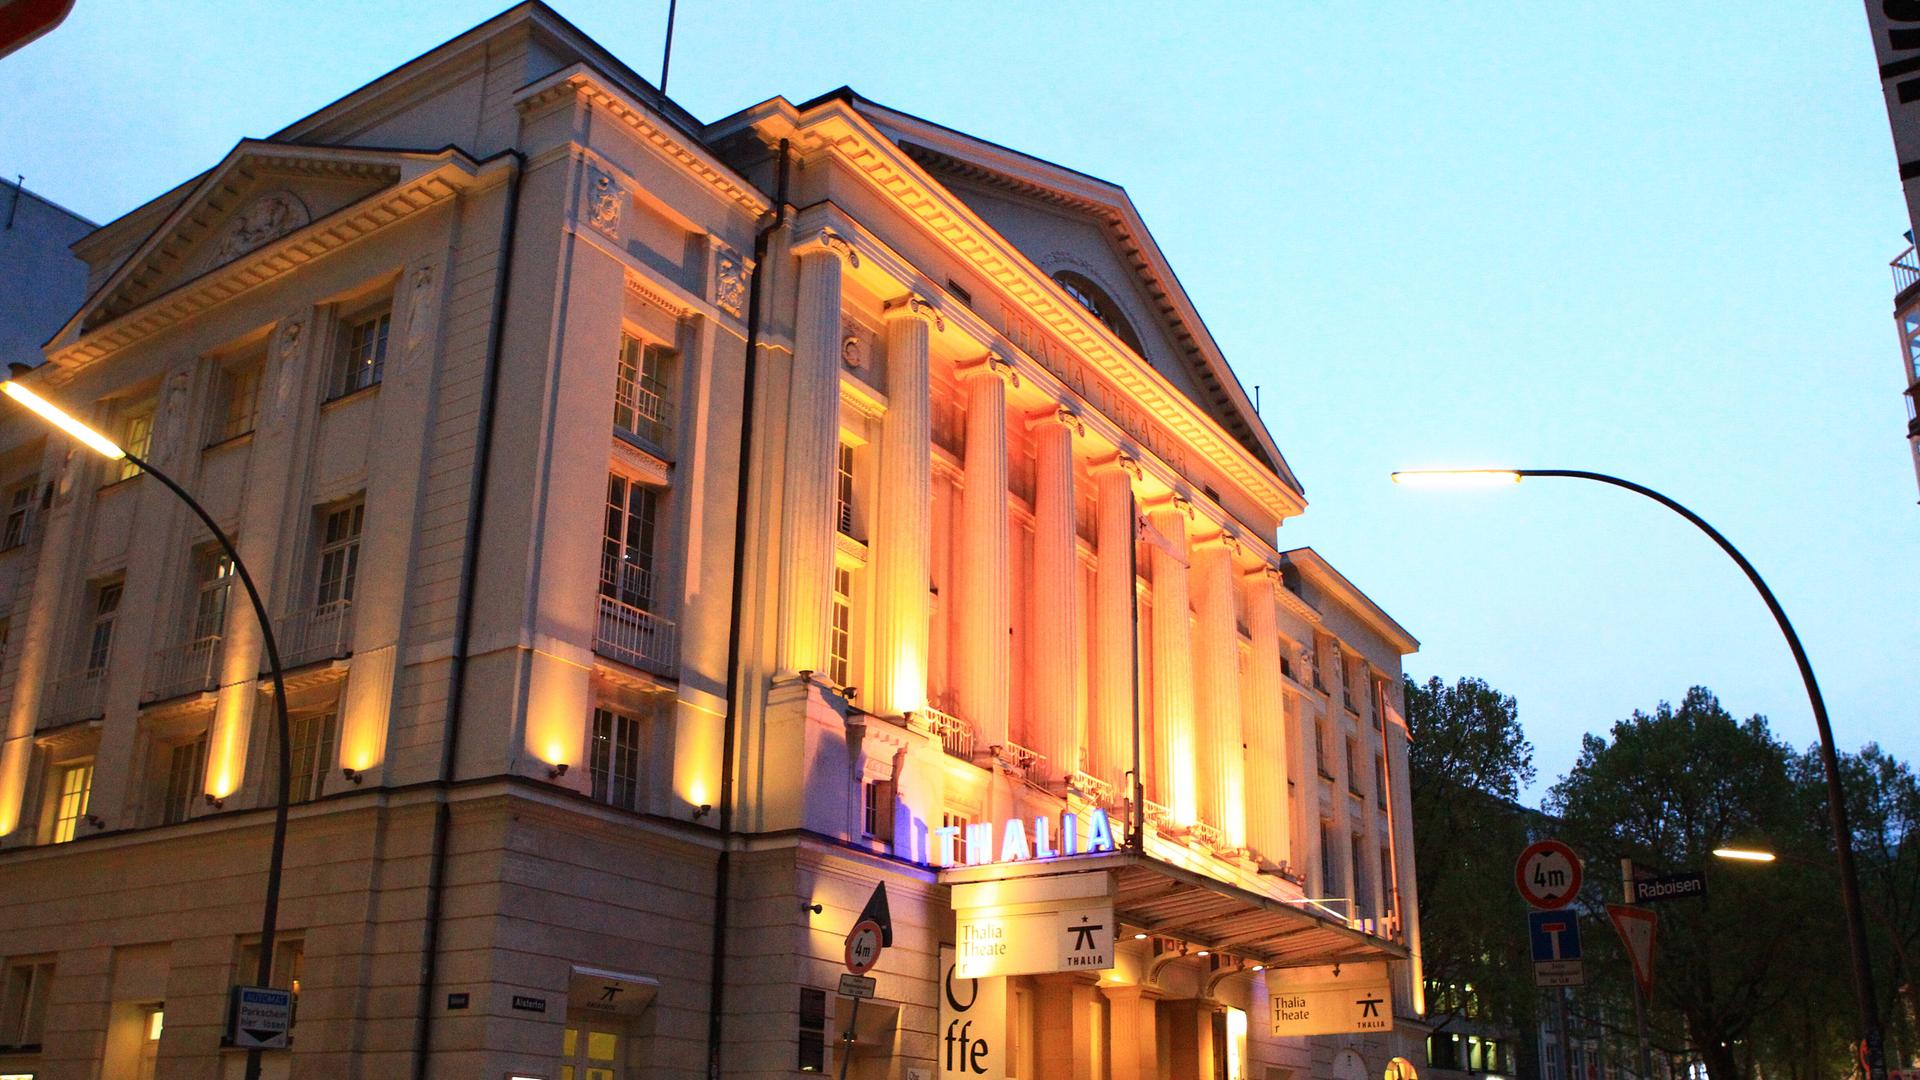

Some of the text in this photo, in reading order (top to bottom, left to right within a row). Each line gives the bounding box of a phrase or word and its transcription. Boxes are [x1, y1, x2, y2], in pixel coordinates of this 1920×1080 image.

[1000, 303, 1187, 476] THALIA THEATER
[935, 807, 1115, 868] THALIA
[1638, 878, 1702, 898] Raboisen
[962, 923, 1003, 941] Thalia
[962, 941, 1007, 957] Theate
[1067, 955, 1103, 966] THALIA
[1274, 996, 1306, 1009] Thalia
[1275, 1009, 1310, 1021] Theate
[1357, 1020, 1385, 1029] THALIA
[945, 1019, 988, 1074] ffe
